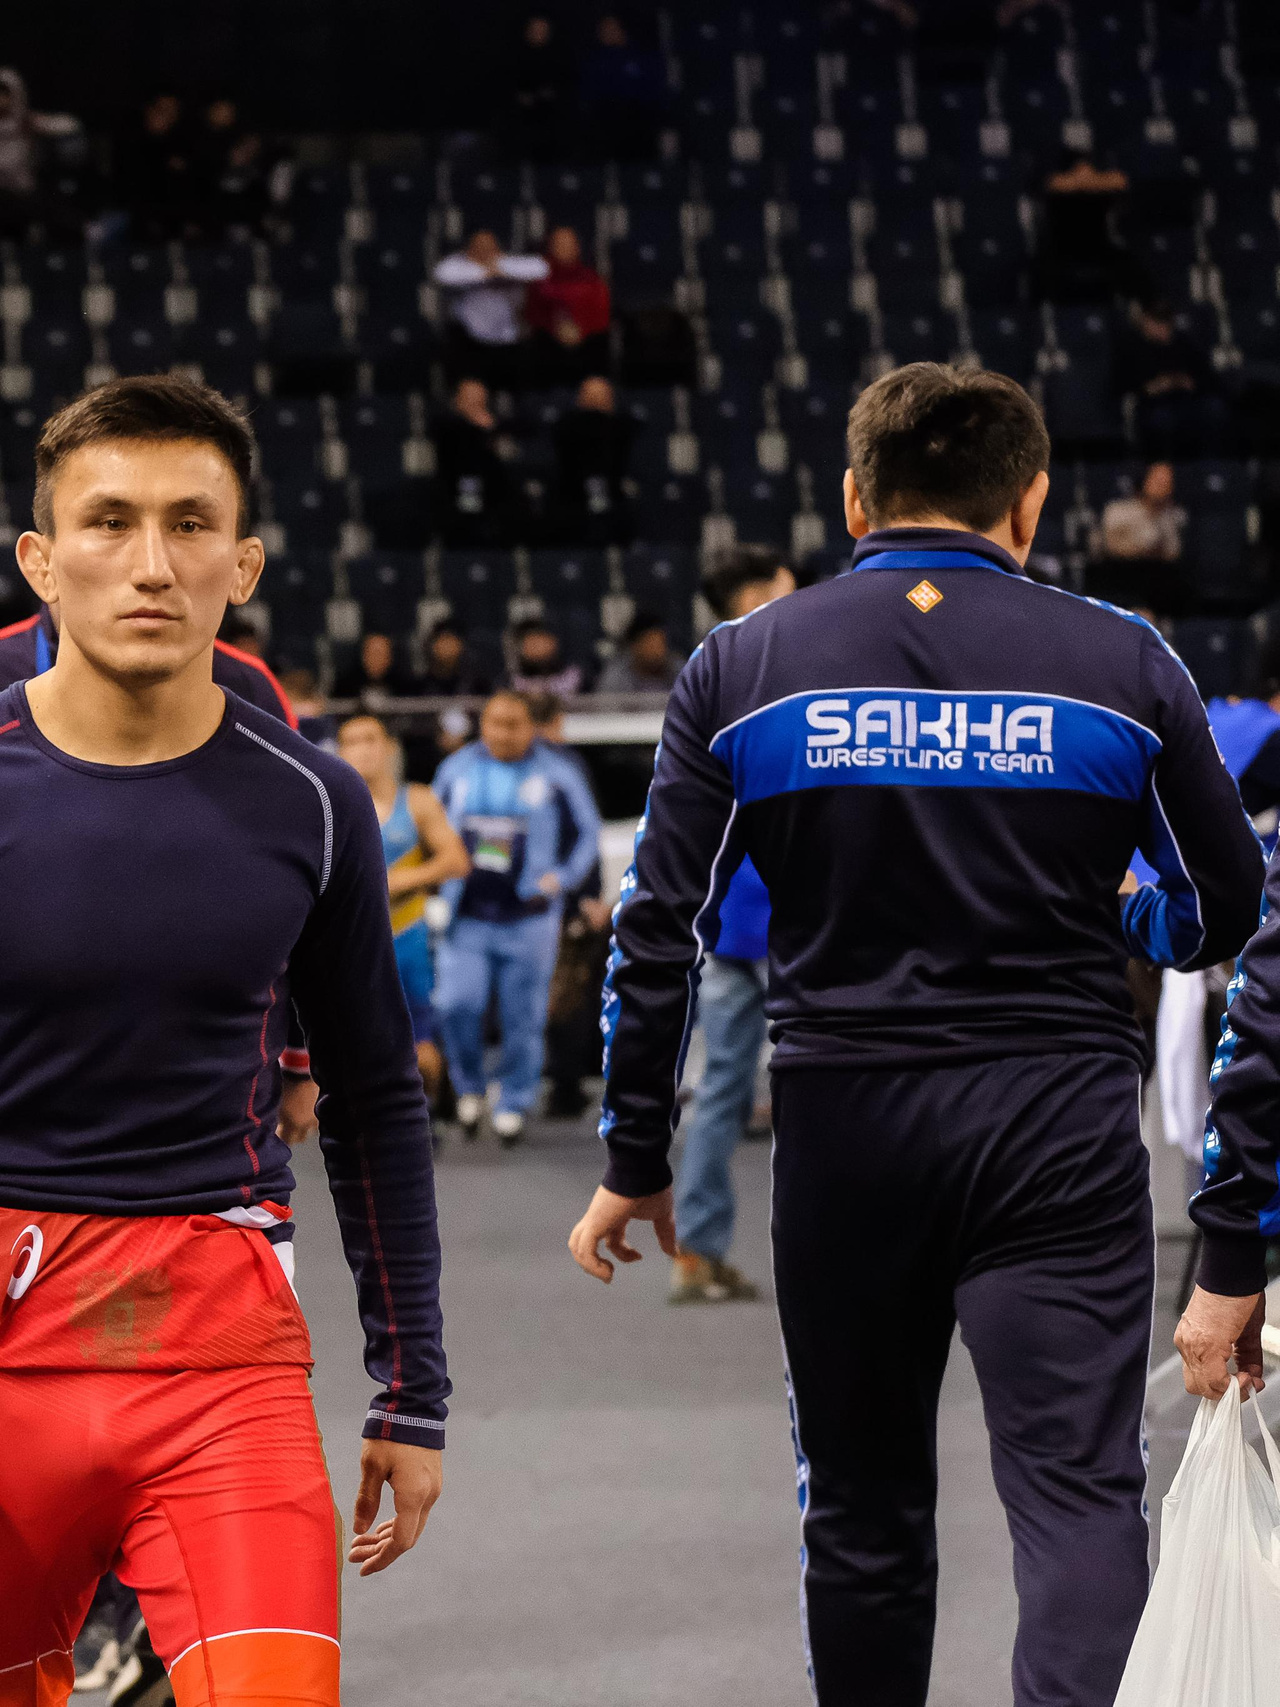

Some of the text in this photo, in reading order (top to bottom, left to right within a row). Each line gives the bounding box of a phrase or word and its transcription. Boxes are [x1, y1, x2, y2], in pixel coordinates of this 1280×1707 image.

[806, 699, 1054, 752] SAKHA
[806, 748, 1054, 773] WRESTLING TEAM
